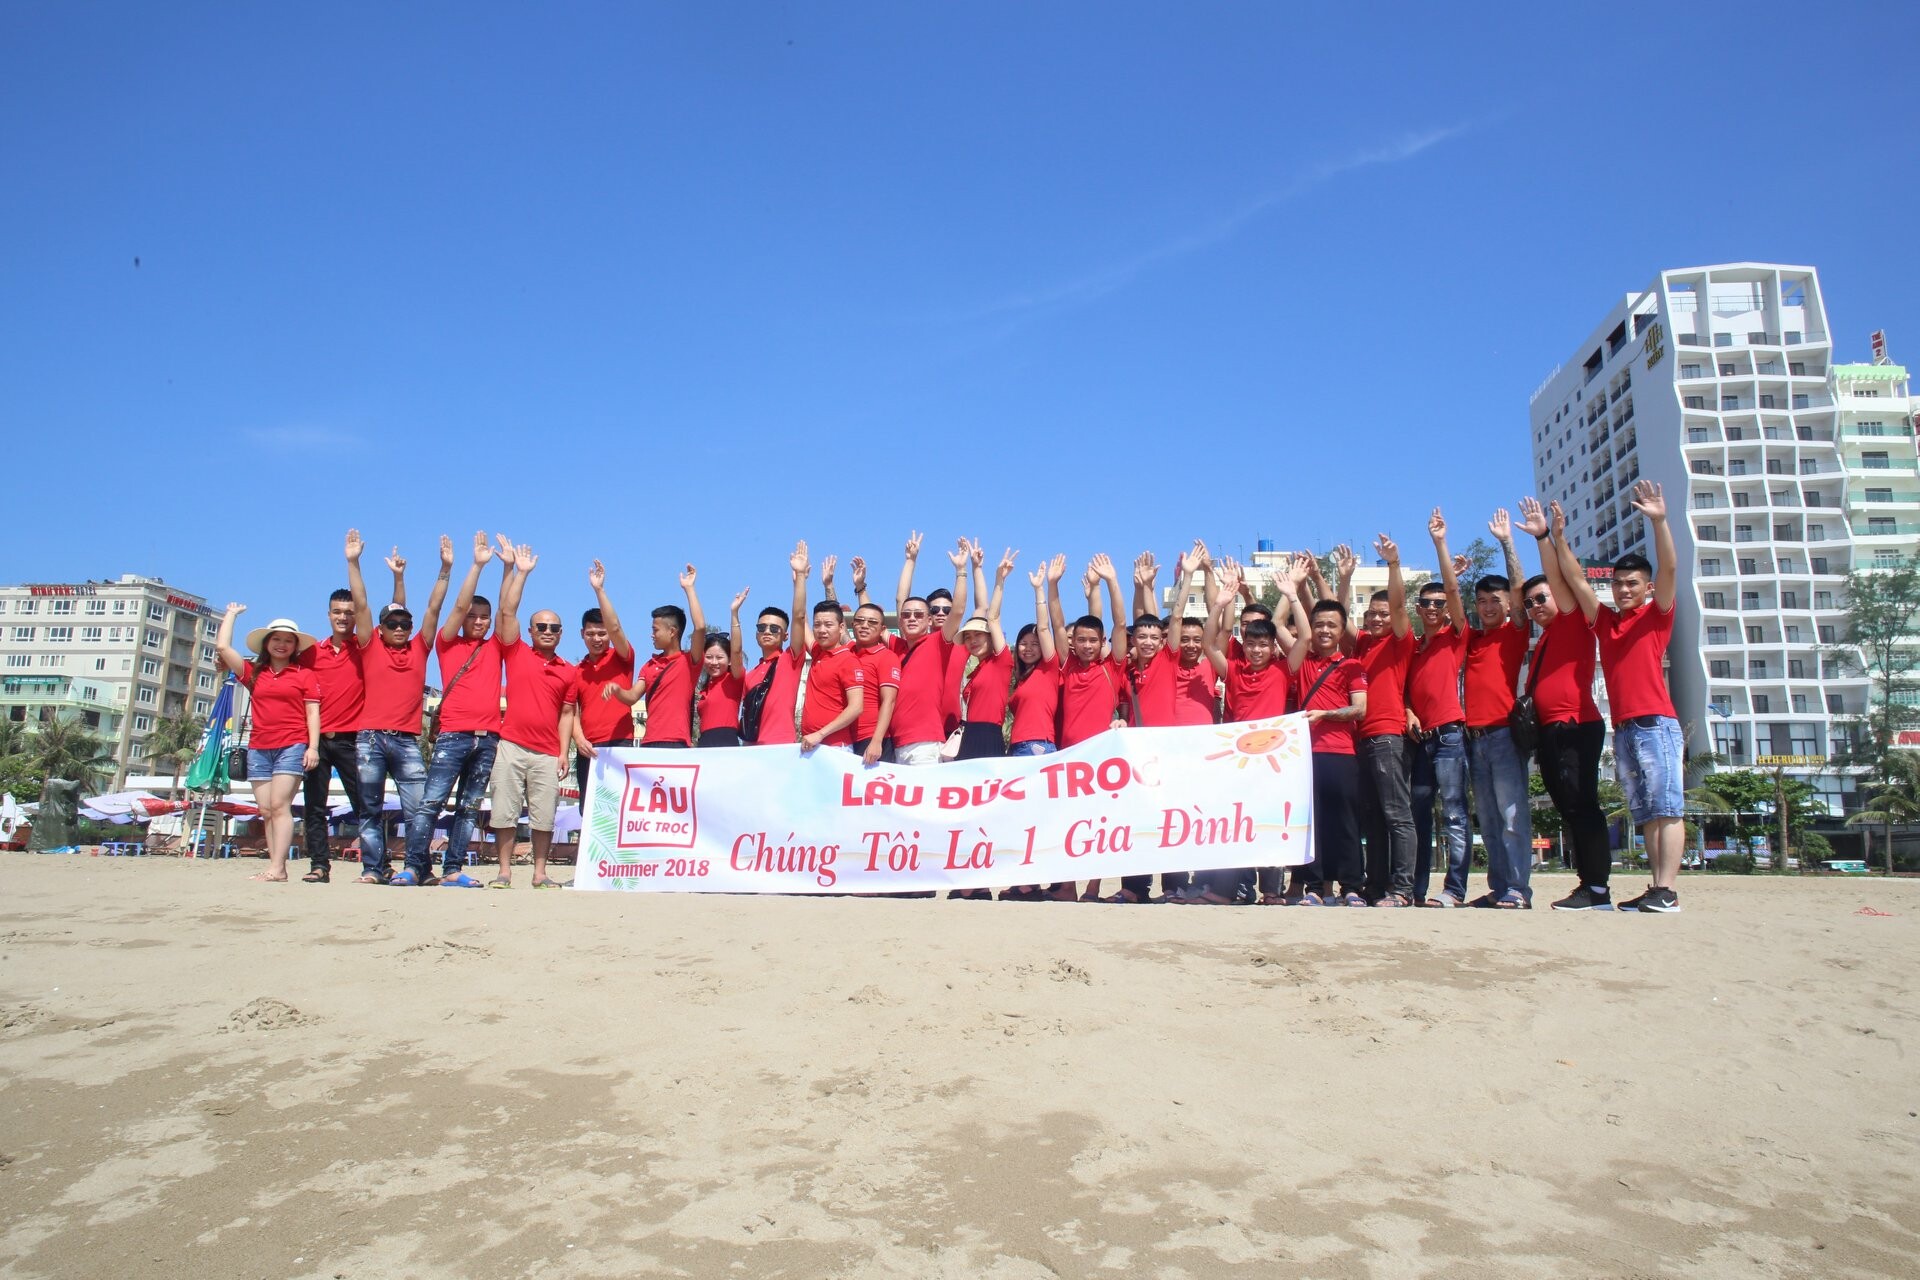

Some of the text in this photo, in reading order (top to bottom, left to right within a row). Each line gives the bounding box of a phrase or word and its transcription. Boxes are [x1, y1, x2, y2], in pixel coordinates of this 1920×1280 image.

[1587, 566, 1615, 578] HOT
[629, 776, 688, 814] LẨU
[842, 773, 924, 807] LẨU
[936, 776, 1026, 810] ĐỨC
[625, 818, 651, 832] ĐỨC
[730, 831, 840, 887] Chúng
[862, 830, 921, 872] Tôi
[943, 826, 995, 870] Là
[1019, 825, 1036, 866] 1
[1064, 816, 1133, 858] Gia
[1157, 801, 1257, 848] Đình
[597, 858, 710, 878] Summer 2018
